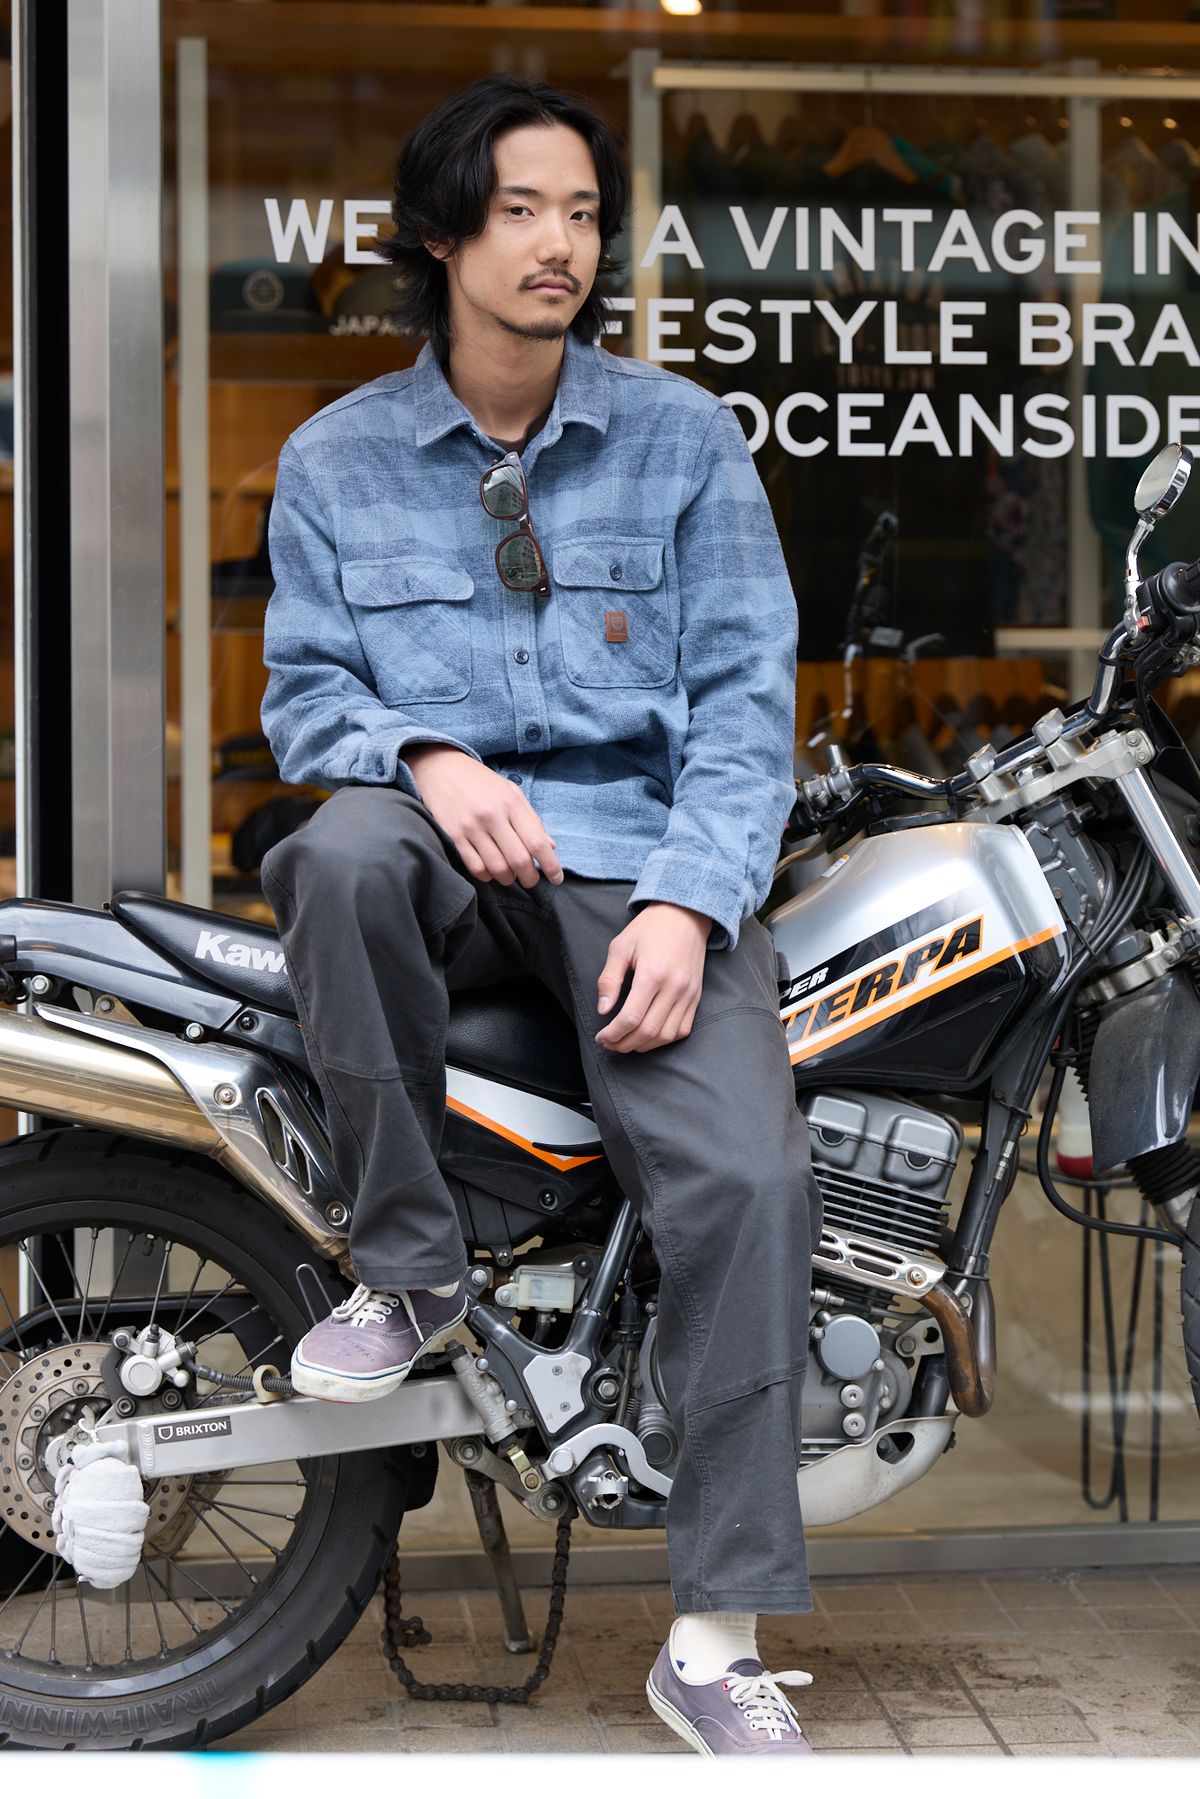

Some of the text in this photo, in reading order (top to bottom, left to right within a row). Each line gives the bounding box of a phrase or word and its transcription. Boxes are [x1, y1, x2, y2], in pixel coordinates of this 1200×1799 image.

[264, 198, 1200, 275] WE A VINTAGE IN
[328, 314, 412, 336] JAPA
[1019, 302, 1200, 367] BRA
[194, 930, 289, 976] Kaw
[175, 1421, 228, 1437] BRIXTON
